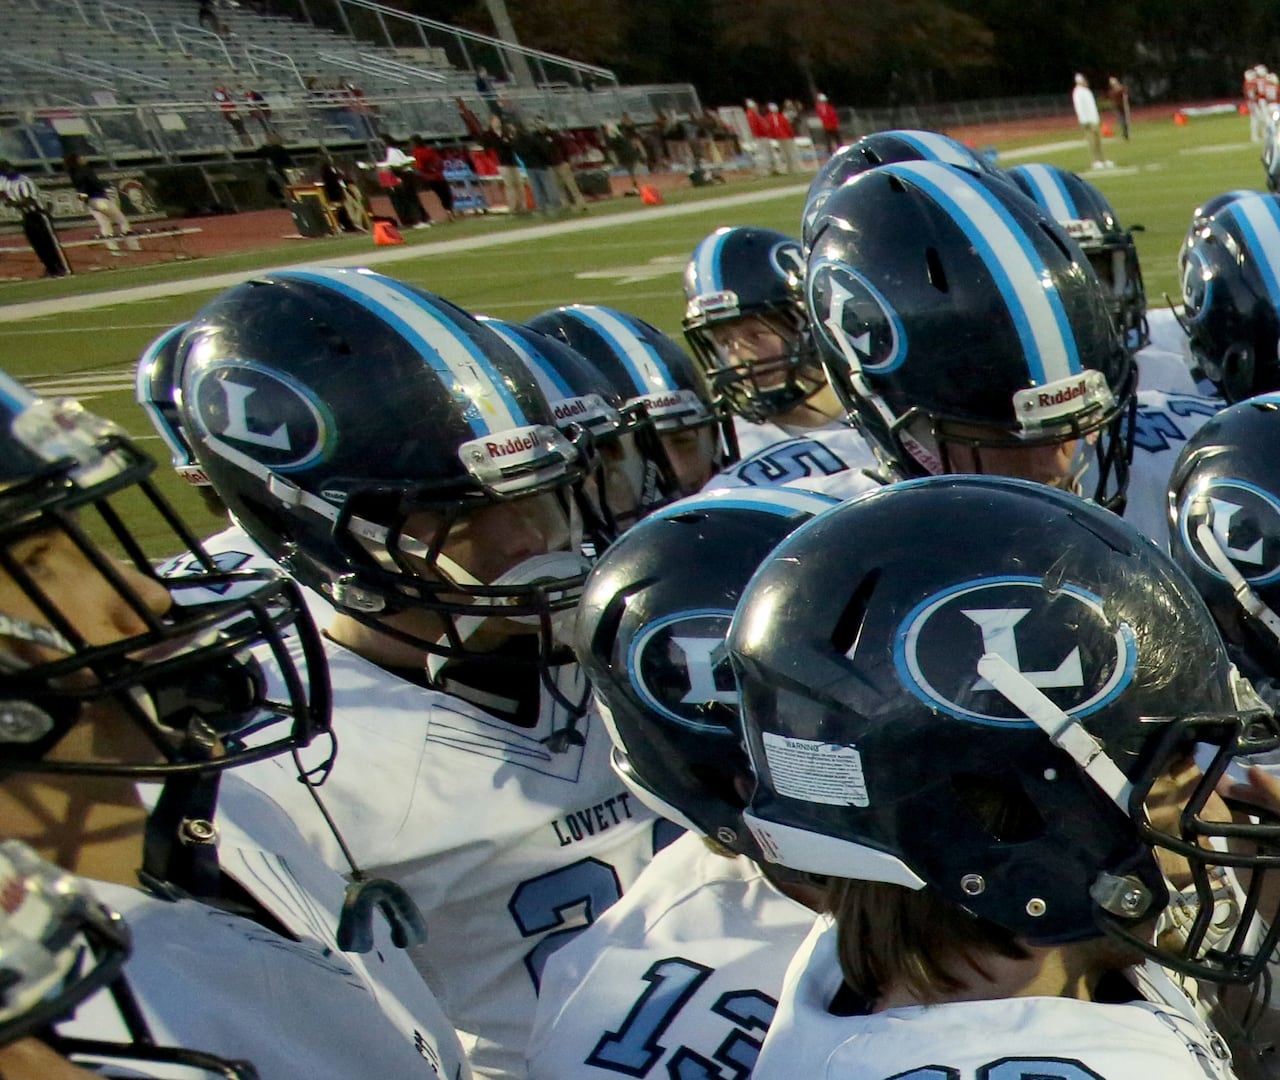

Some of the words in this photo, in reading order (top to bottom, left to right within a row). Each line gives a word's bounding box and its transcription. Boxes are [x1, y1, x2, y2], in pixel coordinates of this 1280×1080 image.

[826, 276, 870, 356] L
[220, 379, 291, 450] L
[1038, 381, 1087, 409] Riddell
[486, 431, 541, 458] Riddell
[1209, 498, 1263, 566] L
[960, 608, 1084, 692] L
[551, 794, 634, 847] LOVETT
